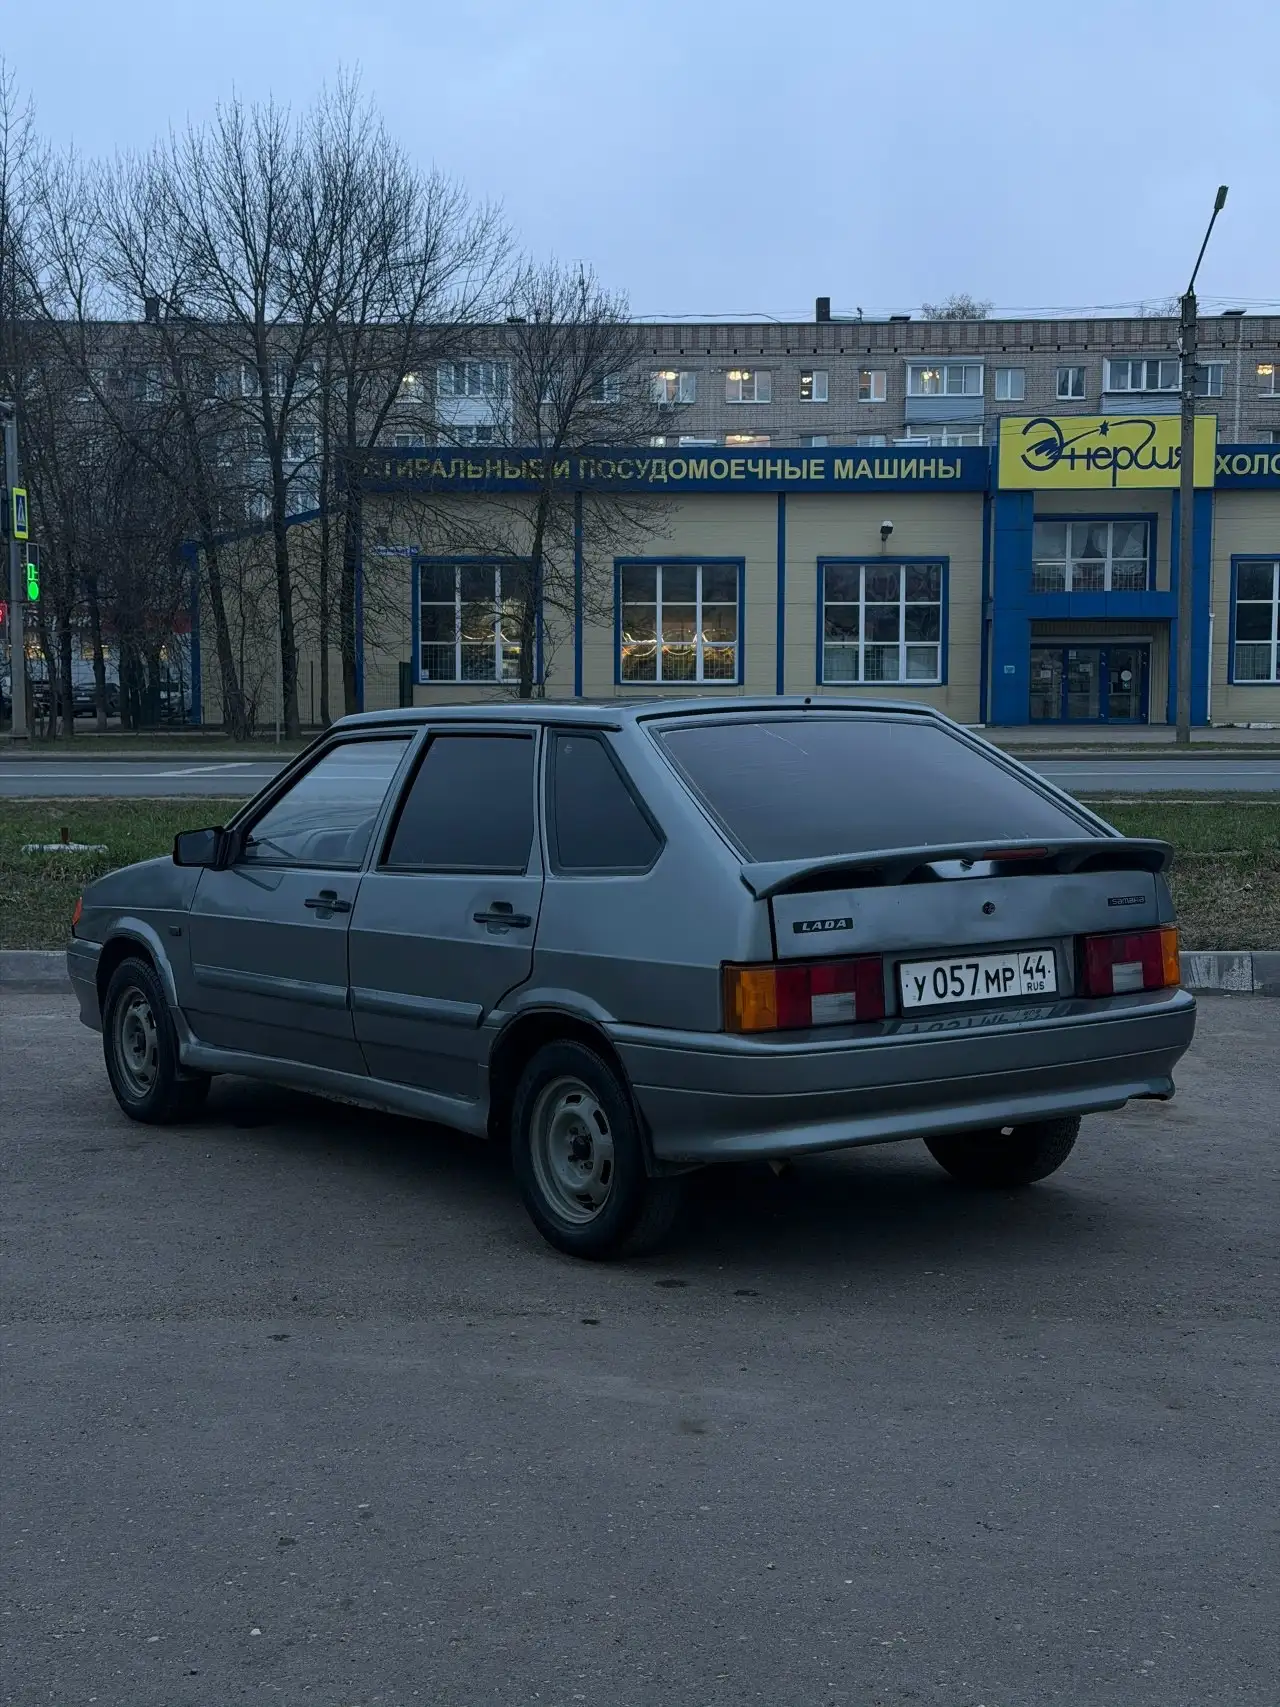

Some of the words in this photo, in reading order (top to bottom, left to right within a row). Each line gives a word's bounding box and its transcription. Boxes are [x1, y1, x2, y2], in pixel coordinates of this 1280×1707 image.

[552, 459, 569, 479] И
[579, 458, 824, 483] ПОСУДОМОЕЧНЫЕ
[834, 458, 962, 479] МАШИНЫ
[802, 920, 846, 931] LADA
[1023, 955, 1046, 981] 44
[1027, 982, 1045, 991] RUS
